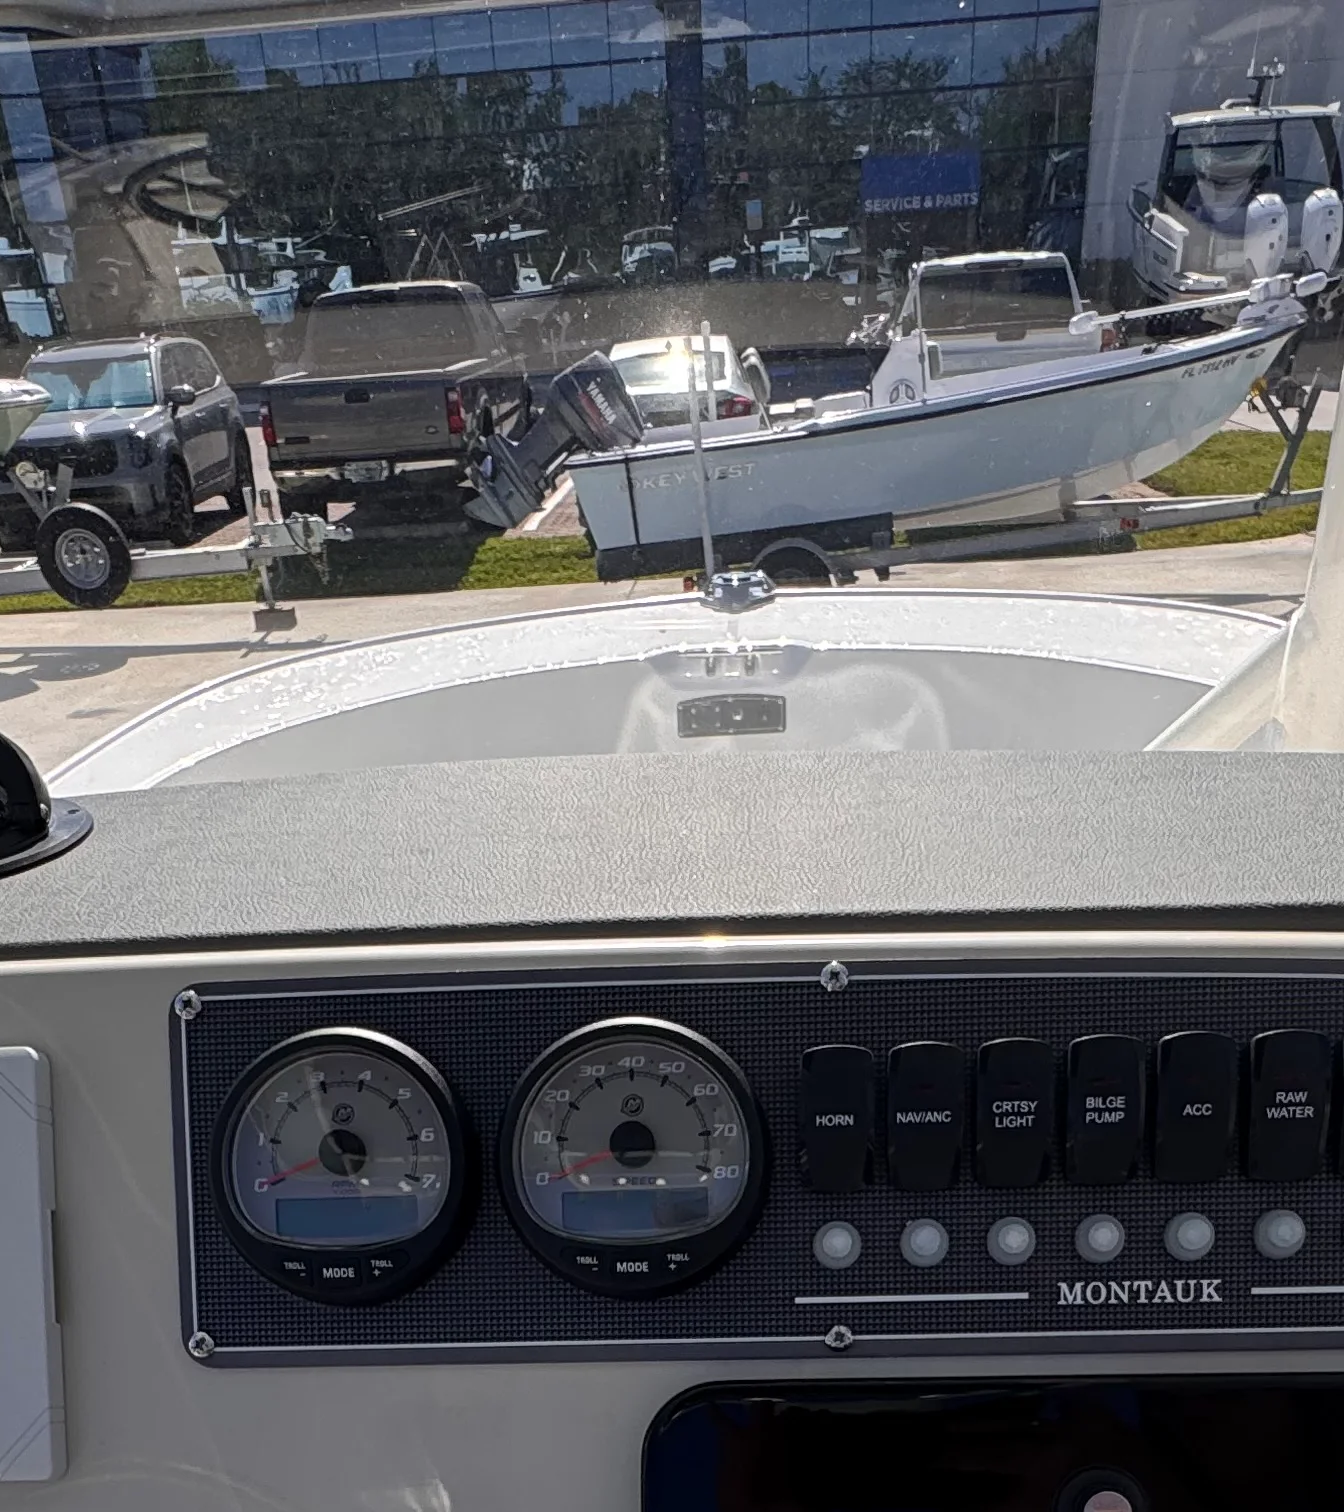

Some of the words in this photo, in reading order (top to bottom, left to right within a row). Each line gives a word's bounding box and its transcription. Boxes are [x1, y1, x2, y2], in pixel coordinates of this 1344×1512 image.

[864, 195, 921, 213] SERVICE
[923, 195, 933, 209] &
[936, 192, 979, 208] PARTS
[586, 381, 617, 425] YAMAHA
[643, 471, 687, 489] KEY
[617, 1056, 645, 1068] 40
[659, 1062, 685, 1073] 50
[579, 1065, 605, 1077] 30
[397, 1088, 412, 1099] 5
[545, 1090, 570, 1101] 20
[693, 1084, 719, 1096] 60
[275, 1092, 289, 1103] 2
[1085, 1096, 1126, 1110] BILGE
[1275, 1091, 1308, 1104] RAW
[992, 1100, 1038, 1114] CRTSY
[1182, 1103, 1213, 1117] ACC
[1266, 1105, 1315, 1119] WATER
[815, 1114, 854, 1128] HORN
[896, 1110, 952, 1124] NAV/ANC
[994, 1115, 1035, 1129] LIGHT
[1085, 1111, 1125, 1125] PUMP
[420, 1127, 435, 1142] 6
[533, 1130, 551, 1144] 10
[713, 1124, 738, 1137] 70
[713, 1165, 739, 1178] 80
[322, 1267, 355, 1279] MODE
[616, 1262, 649, 1272] MODE
[1057, 1279, 1223, 1305] MONTAUK
